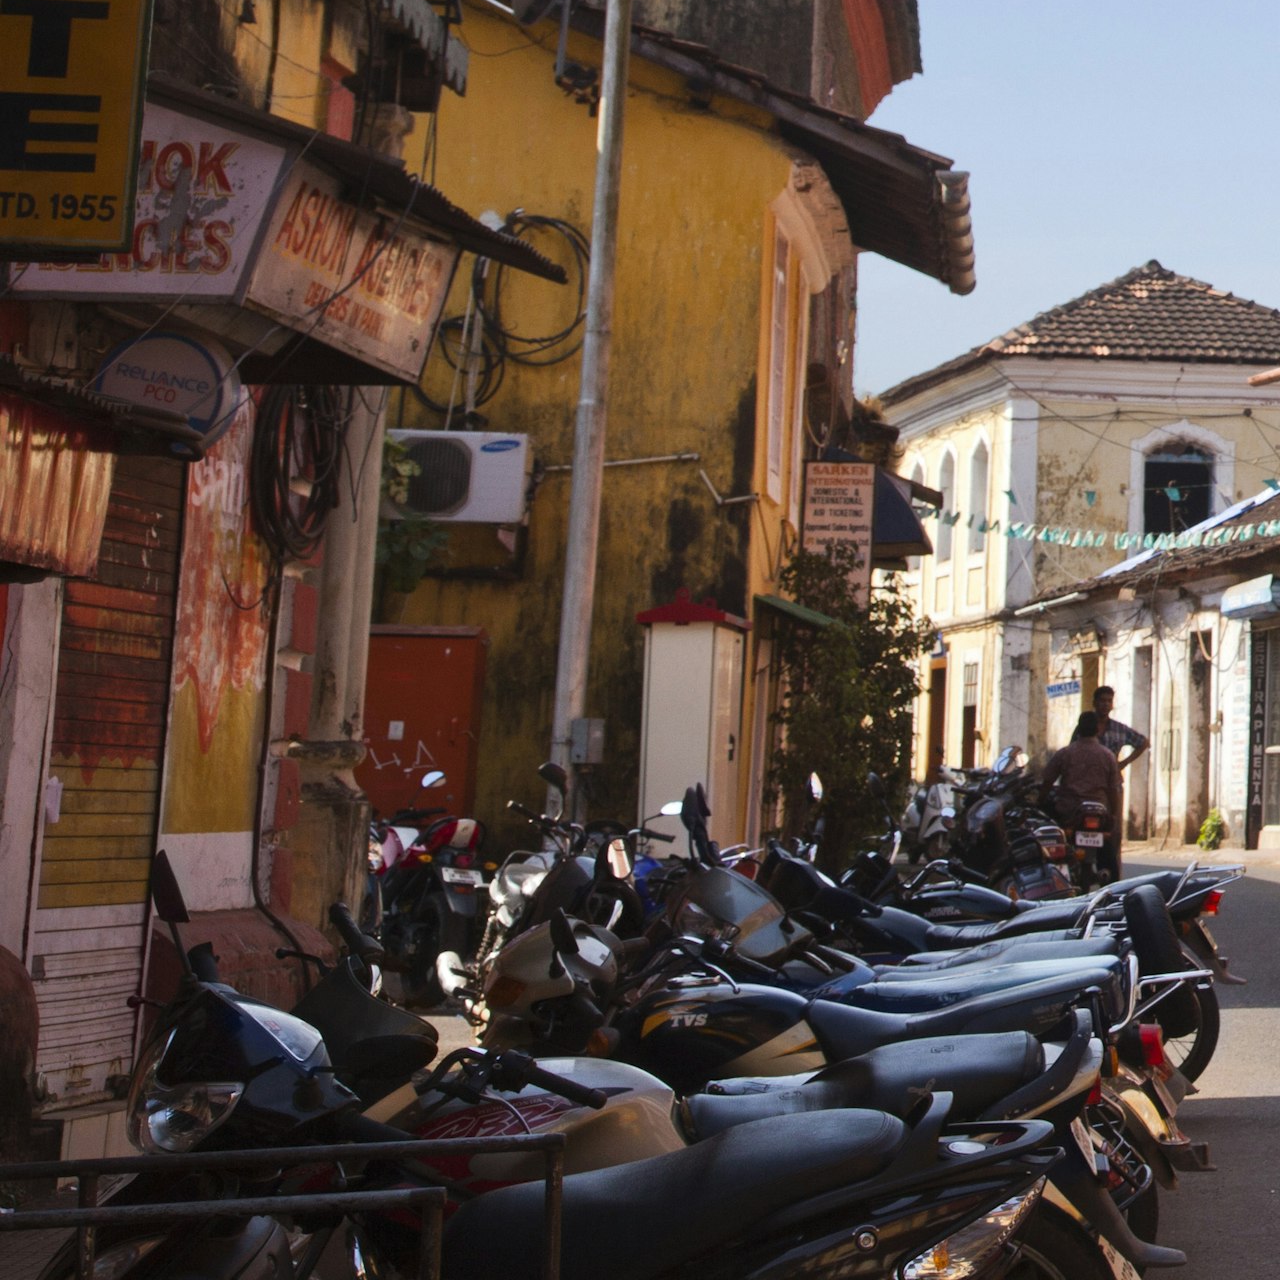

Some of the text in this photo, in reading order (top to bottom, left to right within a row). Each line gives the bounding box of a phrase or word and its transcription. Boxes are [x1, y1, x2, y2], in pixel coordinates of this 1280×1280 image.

[50, 194, 117, 222] 1955
[142, 383, 177, 405] PCO
[1047, 681, 1081, 695] NIKITA
[1251, 628, 1267, 806] PEREIRA PIMENTA
[671, 1013, 709, 1028] TVS
